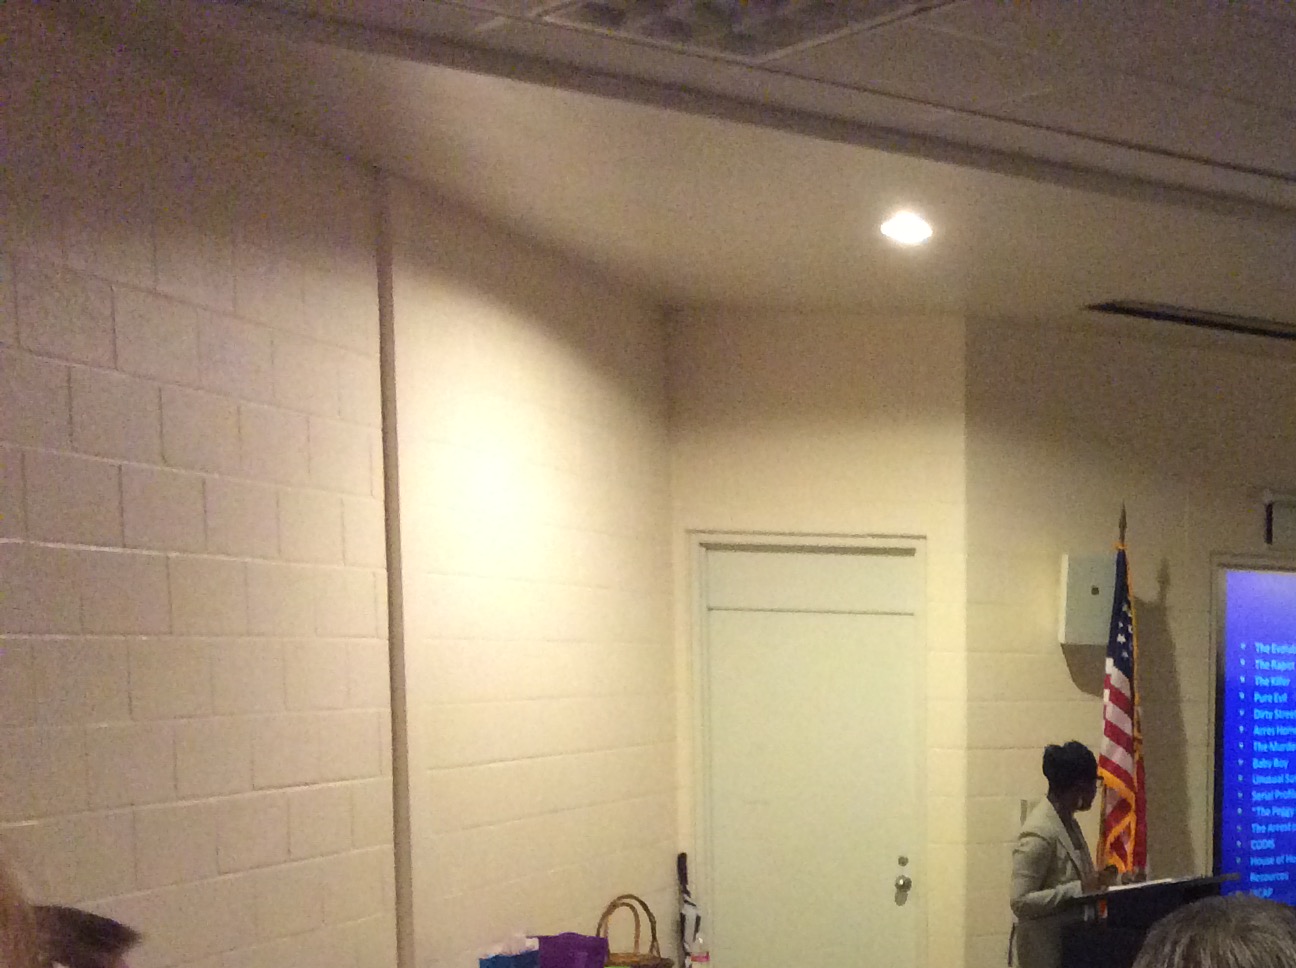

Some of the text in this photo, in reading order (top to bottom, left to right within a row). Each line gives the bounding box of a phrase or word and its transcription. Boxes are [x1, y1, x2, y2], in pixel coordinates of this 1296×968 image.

[1255, 642, 1270, 653] The
[1255, 659, 1270, 670] The
[1255, 676, 1291, 687] The Killer
[1254, 692, 1288, 703] Pure Evil
[1253, 741, 1268, 752] The
[1252, 757, 1290, 769] Baby Boy
[1251, 790, 1274, 801] Serial
[1251, 823, 1267, 834] The
[1267, 822, 1291, 833] Arrest
[1250, 839, 1276, 850] CODIS
[1250, 857, 1275, 866] House
[1275, 855, 1285, 865] of
[1250, 872, 1290, 882] Resources
